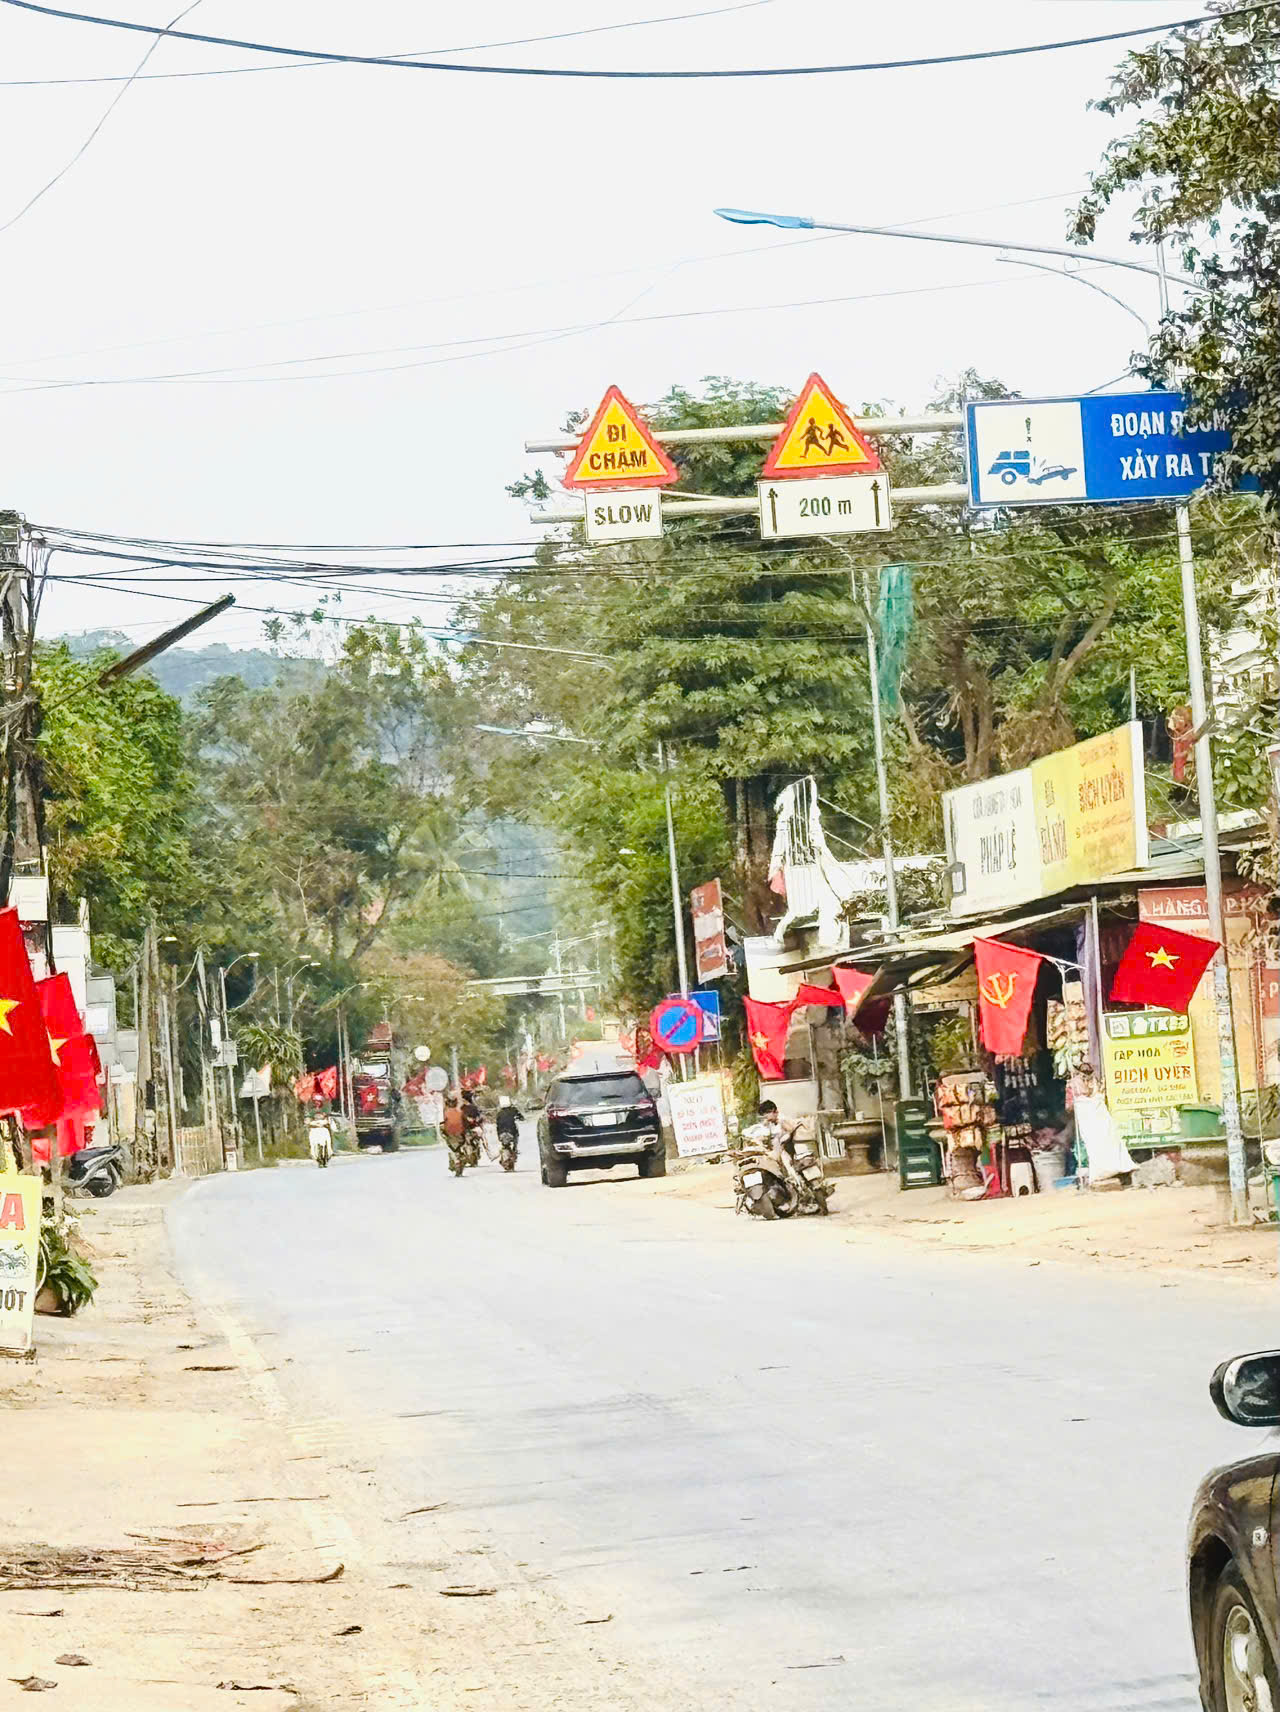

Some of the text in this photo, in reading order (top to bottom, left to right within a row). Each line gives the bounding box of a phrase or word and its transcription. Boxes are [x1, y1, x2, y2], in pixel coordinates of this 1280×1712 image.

[607, 423, 627, 443] ĐI
[1110, 410, 1165, 439] ĐOẠN
[1120, 448, 1160, 480] XẢY
[1166, 453, 1194, 478] RA
[594, 503, 654, 526] SLOW
[799, 497, 852, 518] 200 m
